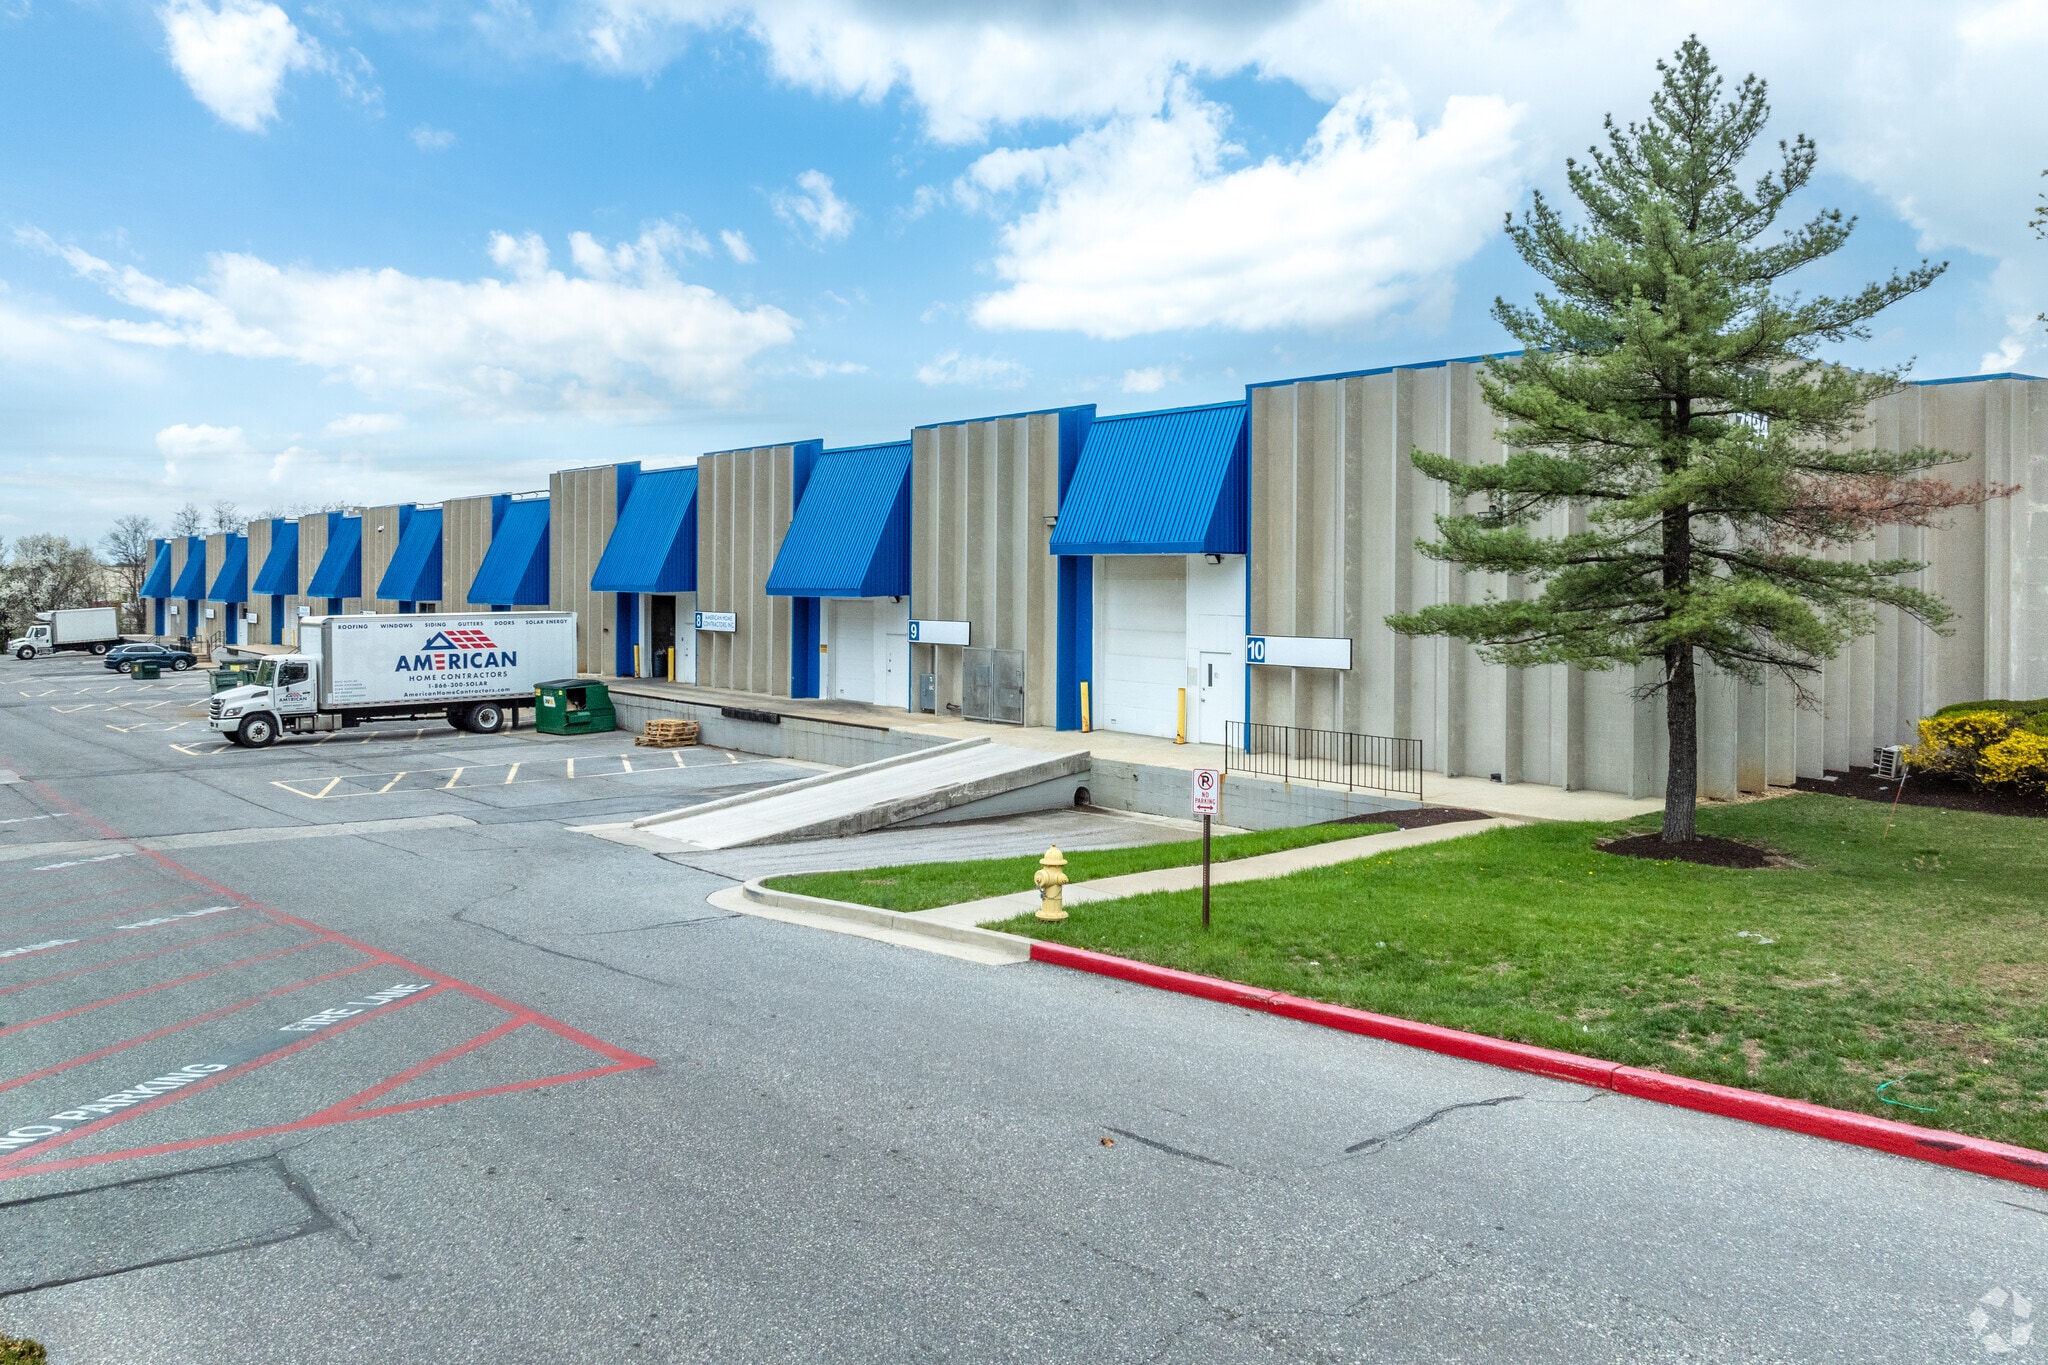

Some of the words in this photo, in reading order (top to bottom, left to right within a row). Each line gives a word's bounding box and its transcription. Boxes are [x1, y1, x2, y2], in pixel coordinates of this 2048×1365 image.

[696, 614, 701, 627] 8
[911, 624, 917, 639] 9
[1248, 640, 1264, 660] 10
[395, 651, 517, 672] AMERICAN
[409, 674, 437, 682] HOME
[441, 671, 508, 680] CONTRACTORS
[428, 681, 488, 689] 1-866-300-SOLAR
[404, 687, 511, 698] AmericanHomeContractors.com
[50, 1064, 228, 1121] PARKING
[279, 1008, 365, 1031] FIRE
[345, 984, 432, 1006] LANE
